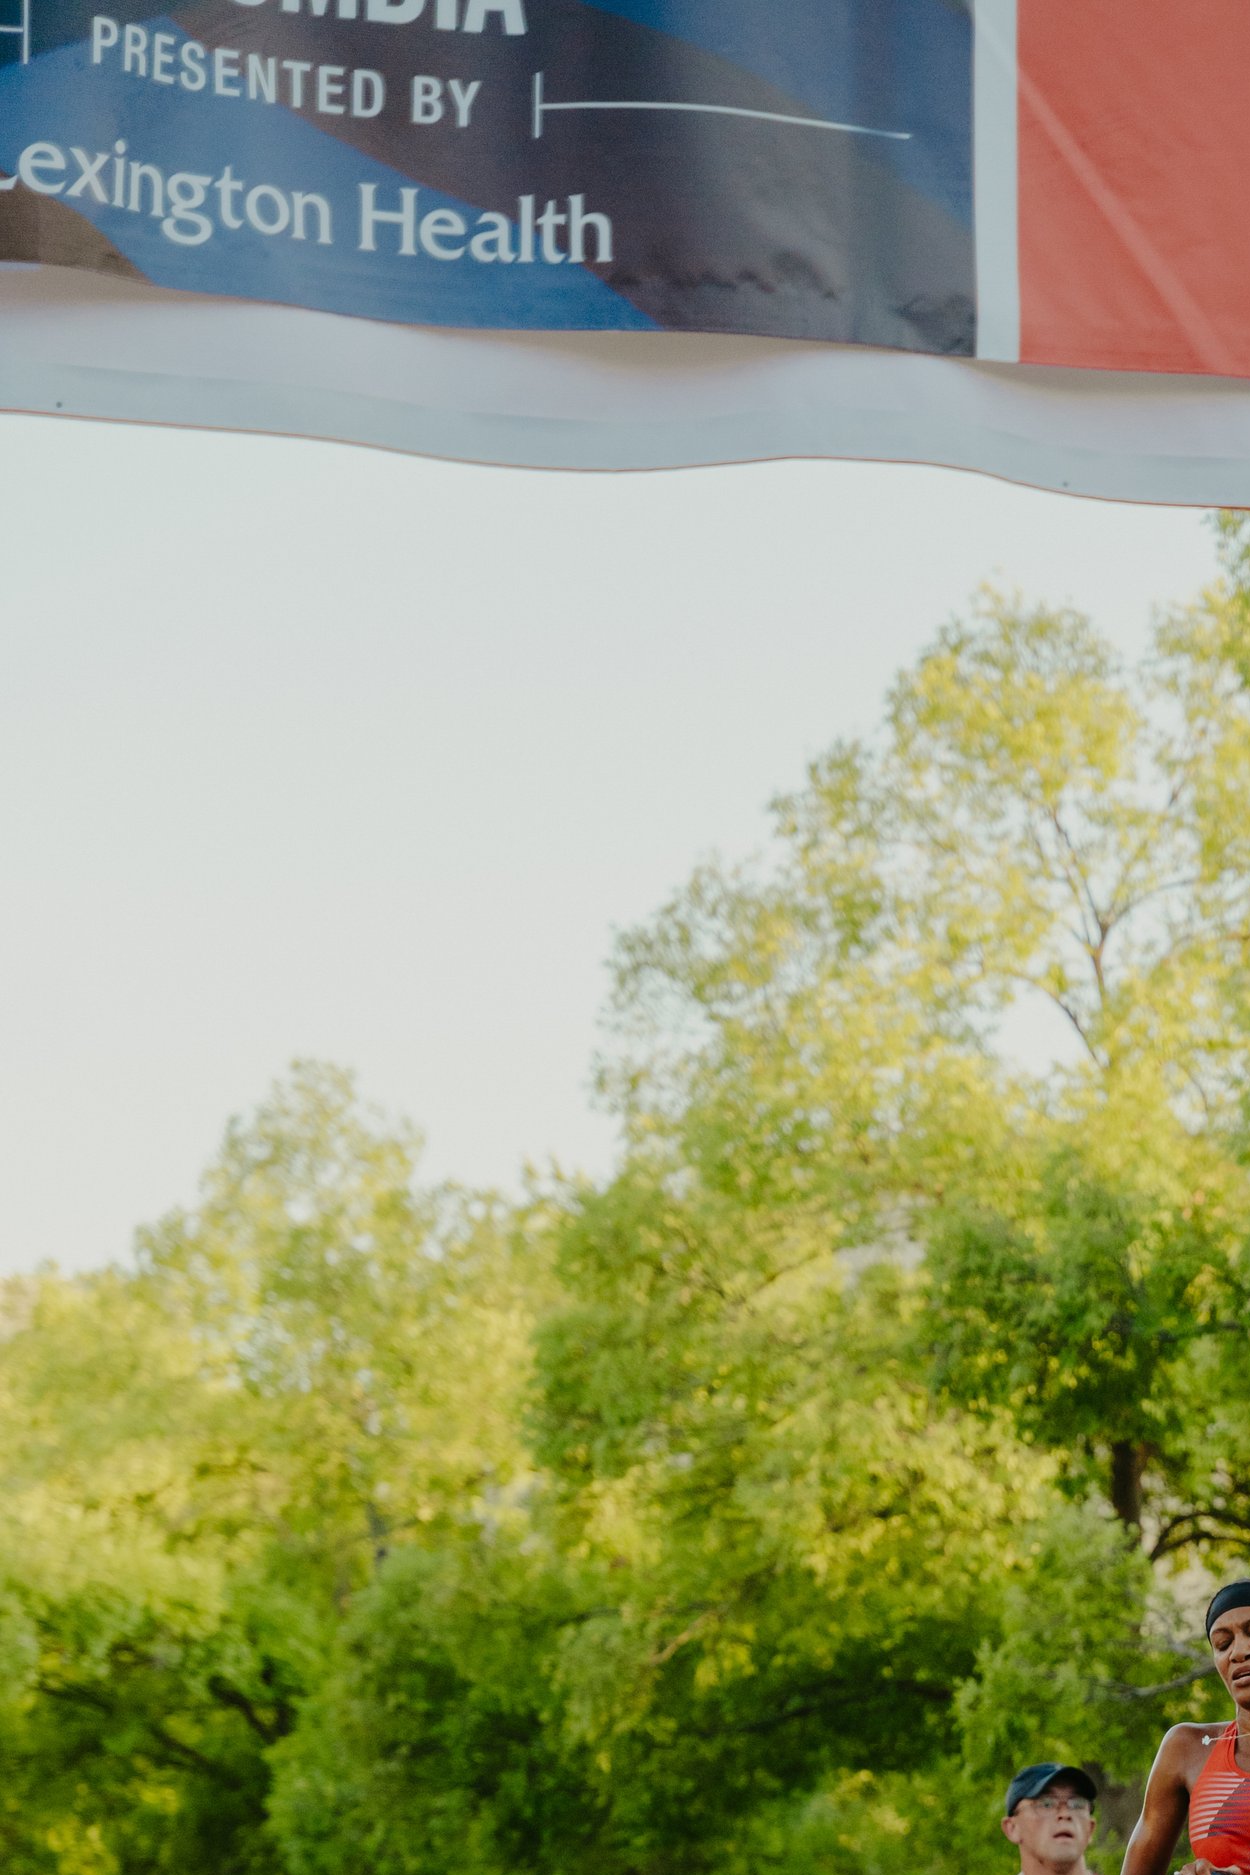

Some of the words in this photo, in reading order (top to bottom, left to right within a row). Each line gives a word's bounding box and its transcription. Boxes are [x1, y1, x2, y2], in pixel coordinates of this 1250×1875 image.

[92, 16, 385, 119] PRESENTED
[411, 76, 482, 127] BY
[358, 183, 613, 264] Health
